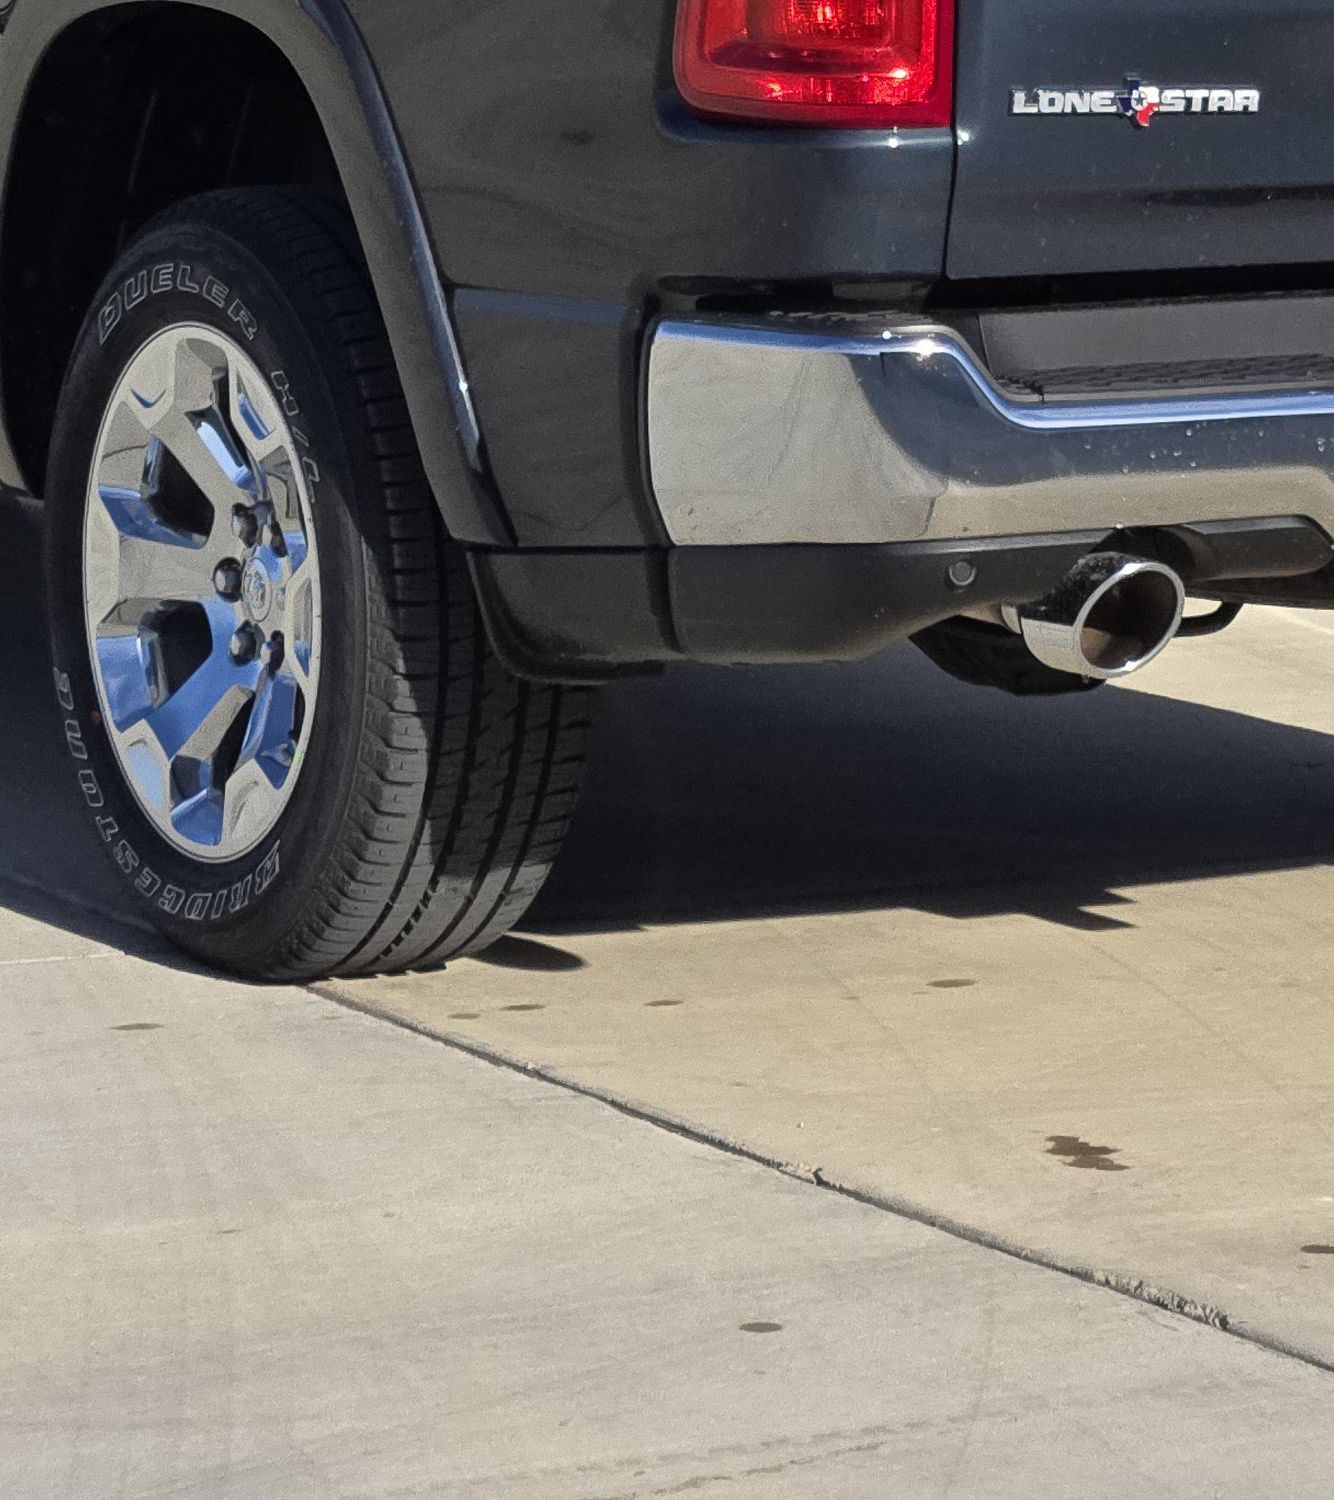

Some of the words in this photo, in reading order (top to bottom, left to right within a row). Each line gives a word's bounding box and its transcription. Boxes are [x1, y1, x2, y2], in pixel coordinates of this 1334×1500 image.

[1011, 89, 1118, 114] LONE
[1159, 89, 1260, 113] STAR
[97, 262, 259, 346] DUELER
[53, 666, 281, 921] BRIDGESTONE
